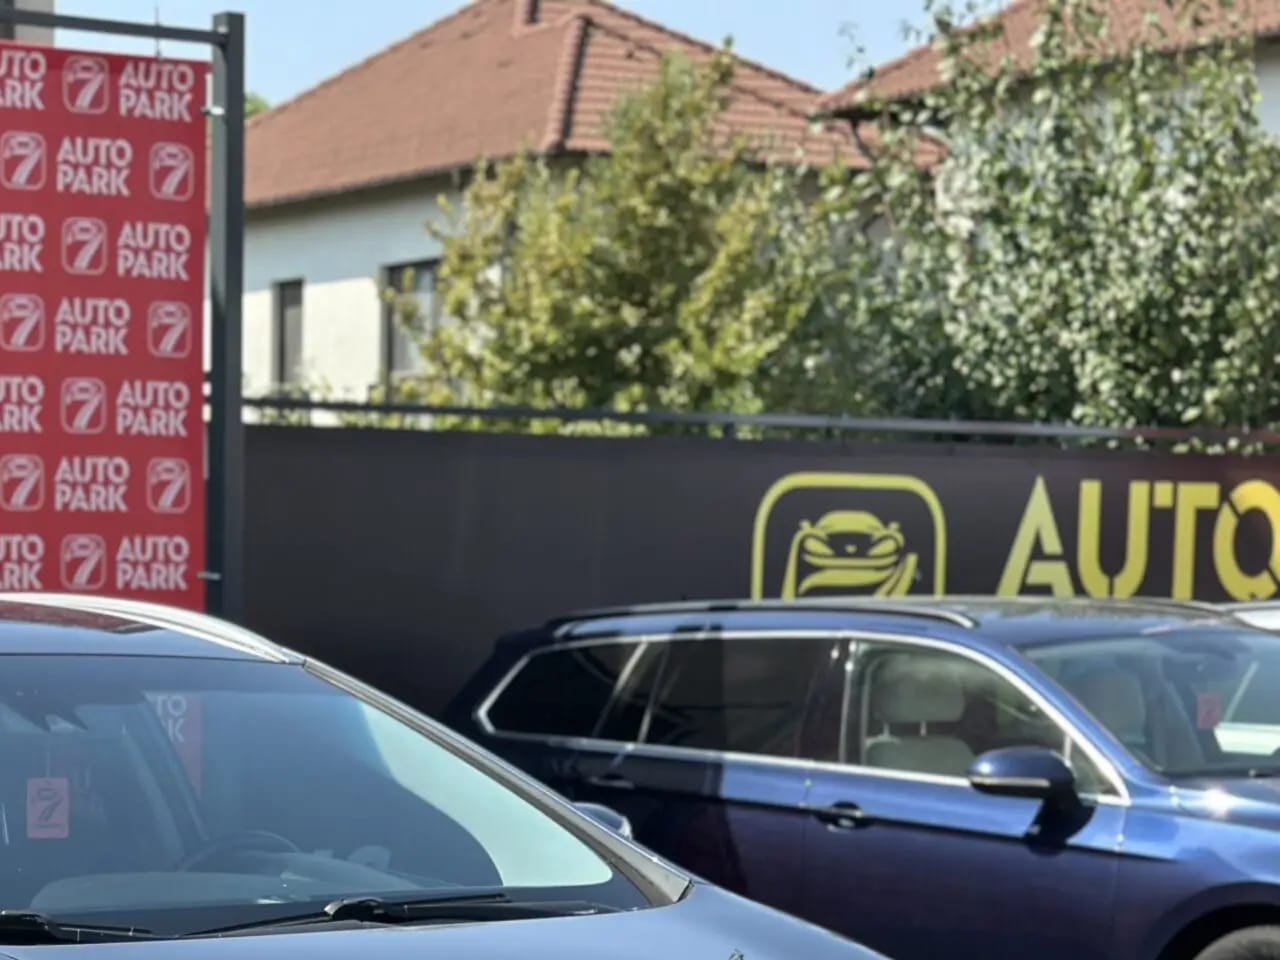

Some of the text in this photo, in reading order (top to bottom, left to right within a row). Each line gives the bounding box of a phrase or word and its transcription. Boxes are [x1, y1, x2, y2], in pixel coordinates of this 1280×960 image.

[119, 61, 194, 91] AUTO
[119, 89, 192, 122] PARK
[57, 137, 132, 167] AUTO
[57, 165, 131, 197] PARK
[118, 222, 191, 252] AUTO
[118, 249, 190, 281] PARK
[55, 295, 130, 326] AUTO
[55, 325, 129, 355] PARK
[116, 380, 190, 409] AUTO
[116, 407, 187, 437] PARK
[55, 456, 130, 484] AUTO
[55, 483, 128, 512] PARK
[117, 535, 189, 562] AUTO
[117, 562, 188, 591] PARK
